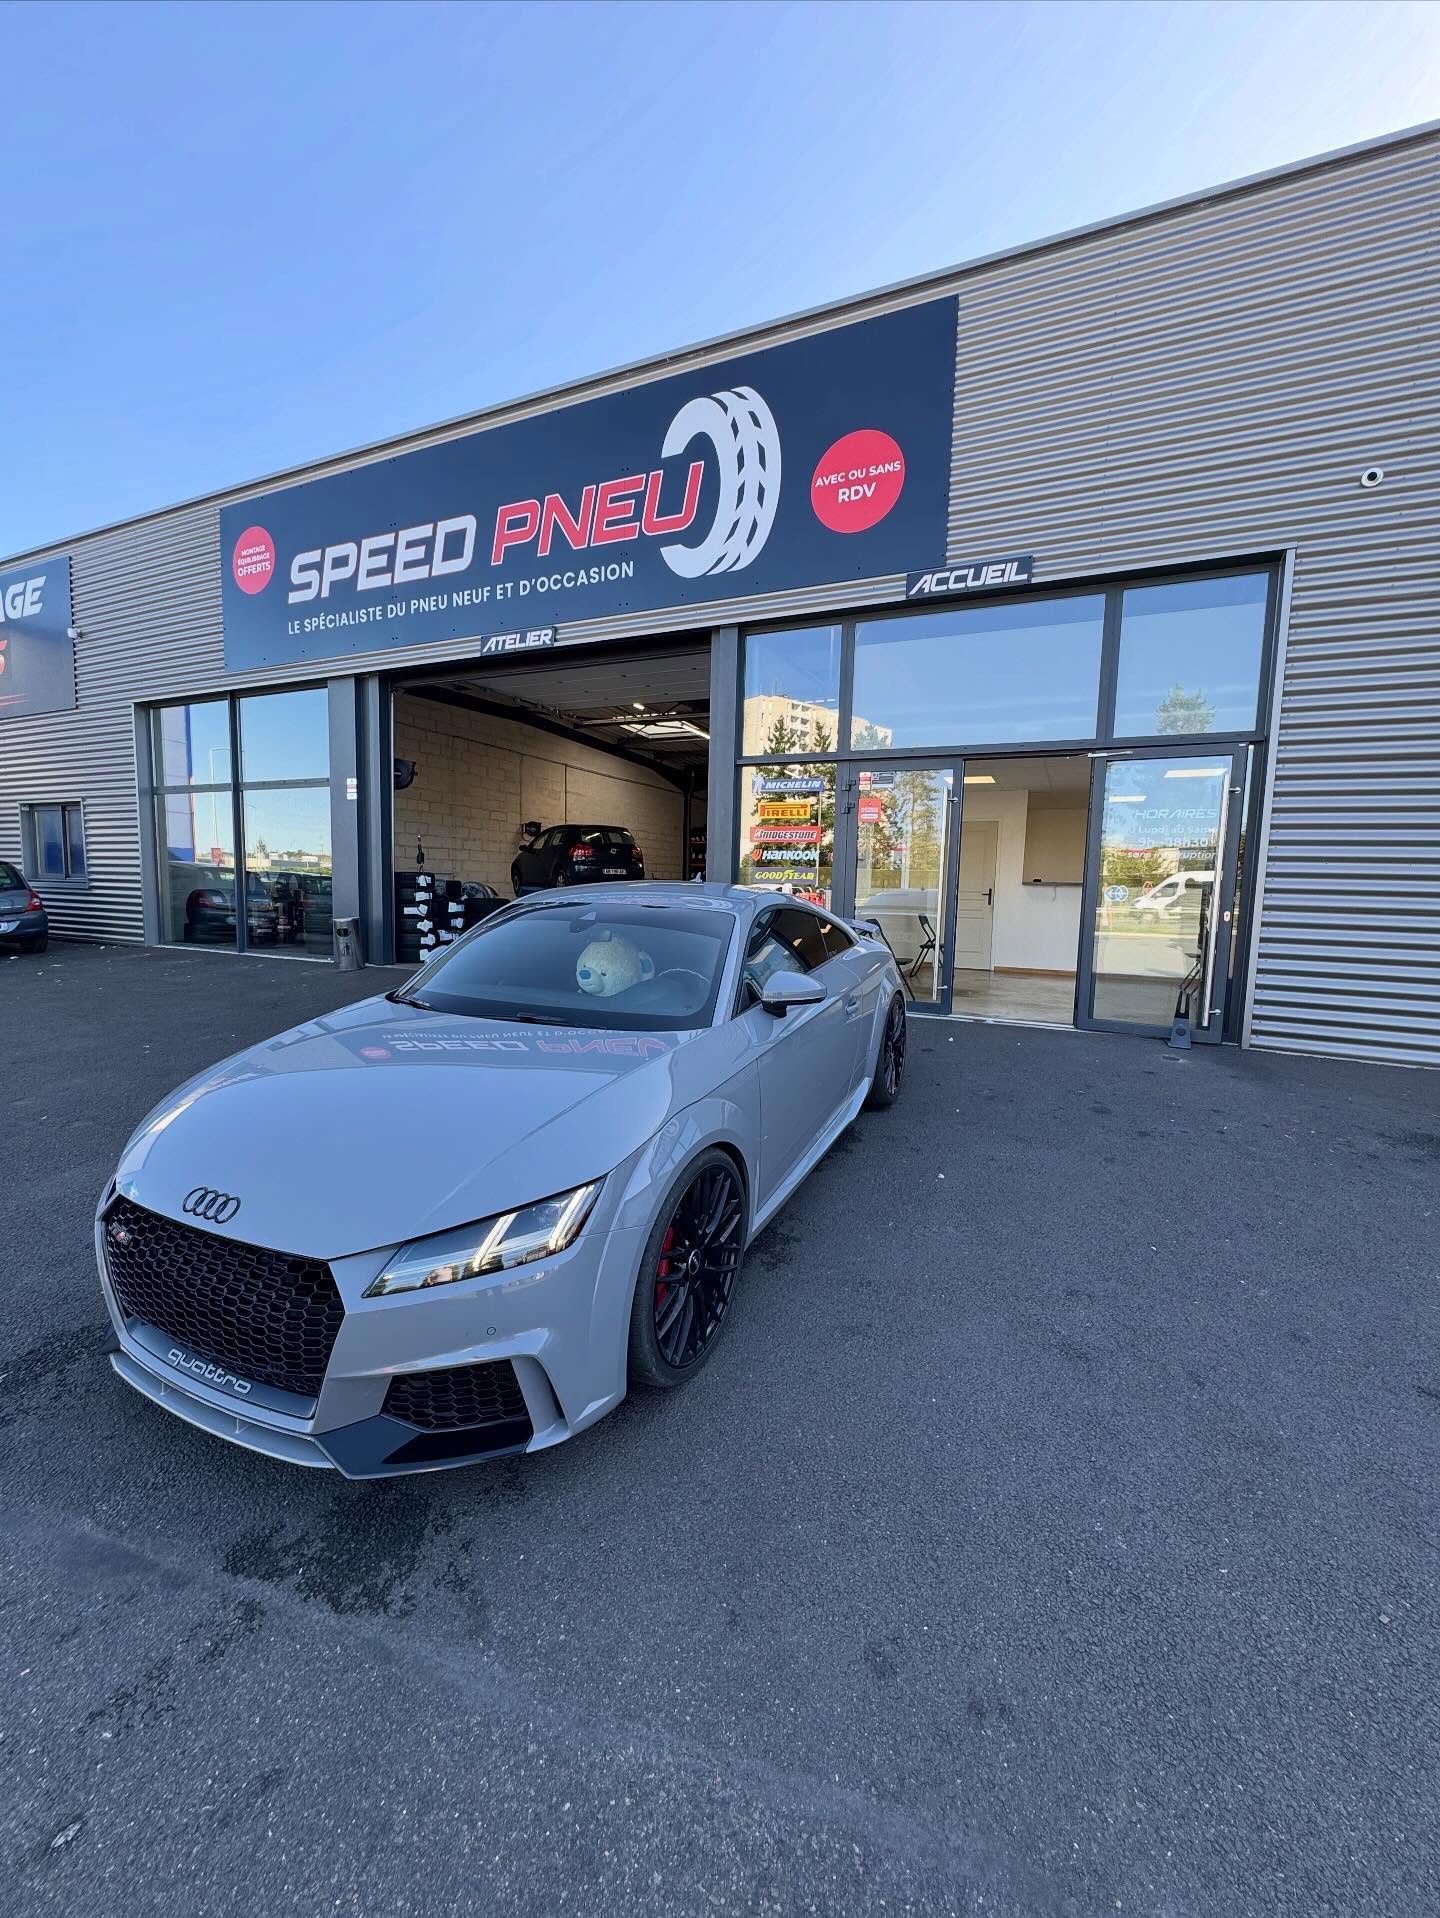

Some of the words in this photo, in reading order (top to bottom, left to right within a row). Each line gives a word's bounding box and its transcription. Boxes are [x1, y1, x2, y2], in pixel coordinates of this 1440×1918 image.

[815, 472, 846, 488] AVEC
[848, 467, 866, 481] OU
[869, 460, 901, 476] SANS
[837, 482, 876, 503] RDV
[288, 514, 477, 605] SPEED
[491, 460, 705, 566] PNEU
[237, 561, 270, 577] OFFERTS
[909, 561, 1028, 596] ACCUEIL
[288, 620, 300, 635] LE
[304, 606, 382, 633] SPÉCIALISTE
[388, 603, 406, 618] DU
[410, 595, 448, 614] PNEU
[453, 587, 491, 607] NEUF
[496, 582, 513, 600] ET
[519, 560, 634, 597] D'OCCASION
[483, 628, 553, 652] ATELIER
[765, 780, 821, 790] MICHELIN
[759, 803, 809, 817] PIRELLI
[1135, 808, 1217, 820] HORAIRES
[754, 829, 817, 840] BRIDGESTONE
[755, 869, 815, 881] GOODYEAR
[168, 1348, 252, 1394] quattro
